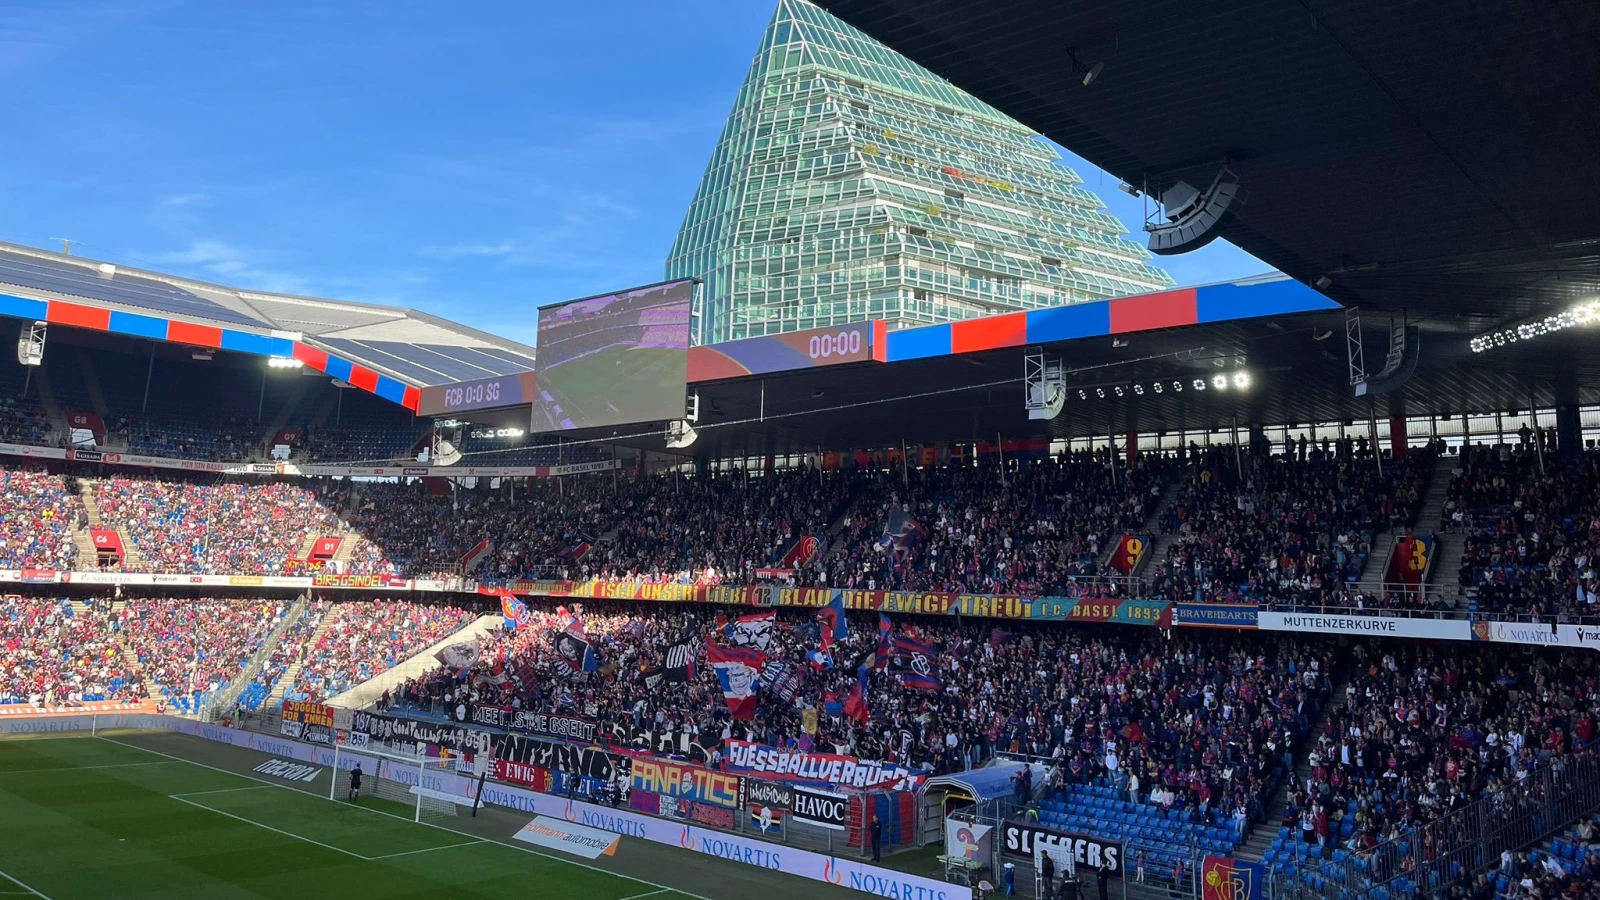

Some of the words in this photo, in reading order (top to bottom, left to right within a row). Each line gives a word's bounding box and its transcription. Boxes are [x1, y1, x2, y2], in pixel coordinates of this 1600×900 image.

[809, 330, 861, 359] 00:00
[444, 387, 463, 407] FCB
[465, 384, 484, 404] 0:0
[486, 382, 500, 401] SG
[74, 415, 87, 424] G8
[284, 433, 295, 441] G9
[206, 463, 224, 471] BASEL
[571, 464, 590, 473] BASEL
[591, 462, 605, 470] 1893
[1126, 538, 1143, 566] 9
[1407, 539, 1428, 571] 3
[755, 588, 771, 604] 12
[779, 588, 832, 607] BLAU
[1073, 604, 1118, 618] BASEL
[1128, 606, 1161, 620] 1893
[1179, 609, 1255, 621] BRAVEHEARTS
[1283, 616, 1397, 632] MUTTENZERKURVE
[1510, 630, 1559, 643] NOVARTIS
[289, 701, 328, 715] JOGGELI
[472, 704, 499, 725] MEE
[11, 720, 81, 733] NOVARTIS
[135, 717, 182, 733] NOVARTIS
[304, 713, 334, 728] IMMER
[203, 728, 233, 744] NOVARTIS
[258, 740, 293, 758] NOVARTIS
[252, 758, 314, 781] macron
[505, 762, 536, 783] EWIG
[560, 772, 595, 796] TEU
[481, 788, 535, 812] NOVARTIS
[795, 794, 845, 821] HAVOC
[582, 810, 646, 838] NOVARTIS
[702, 837, 781, 870] NOVARTIS
